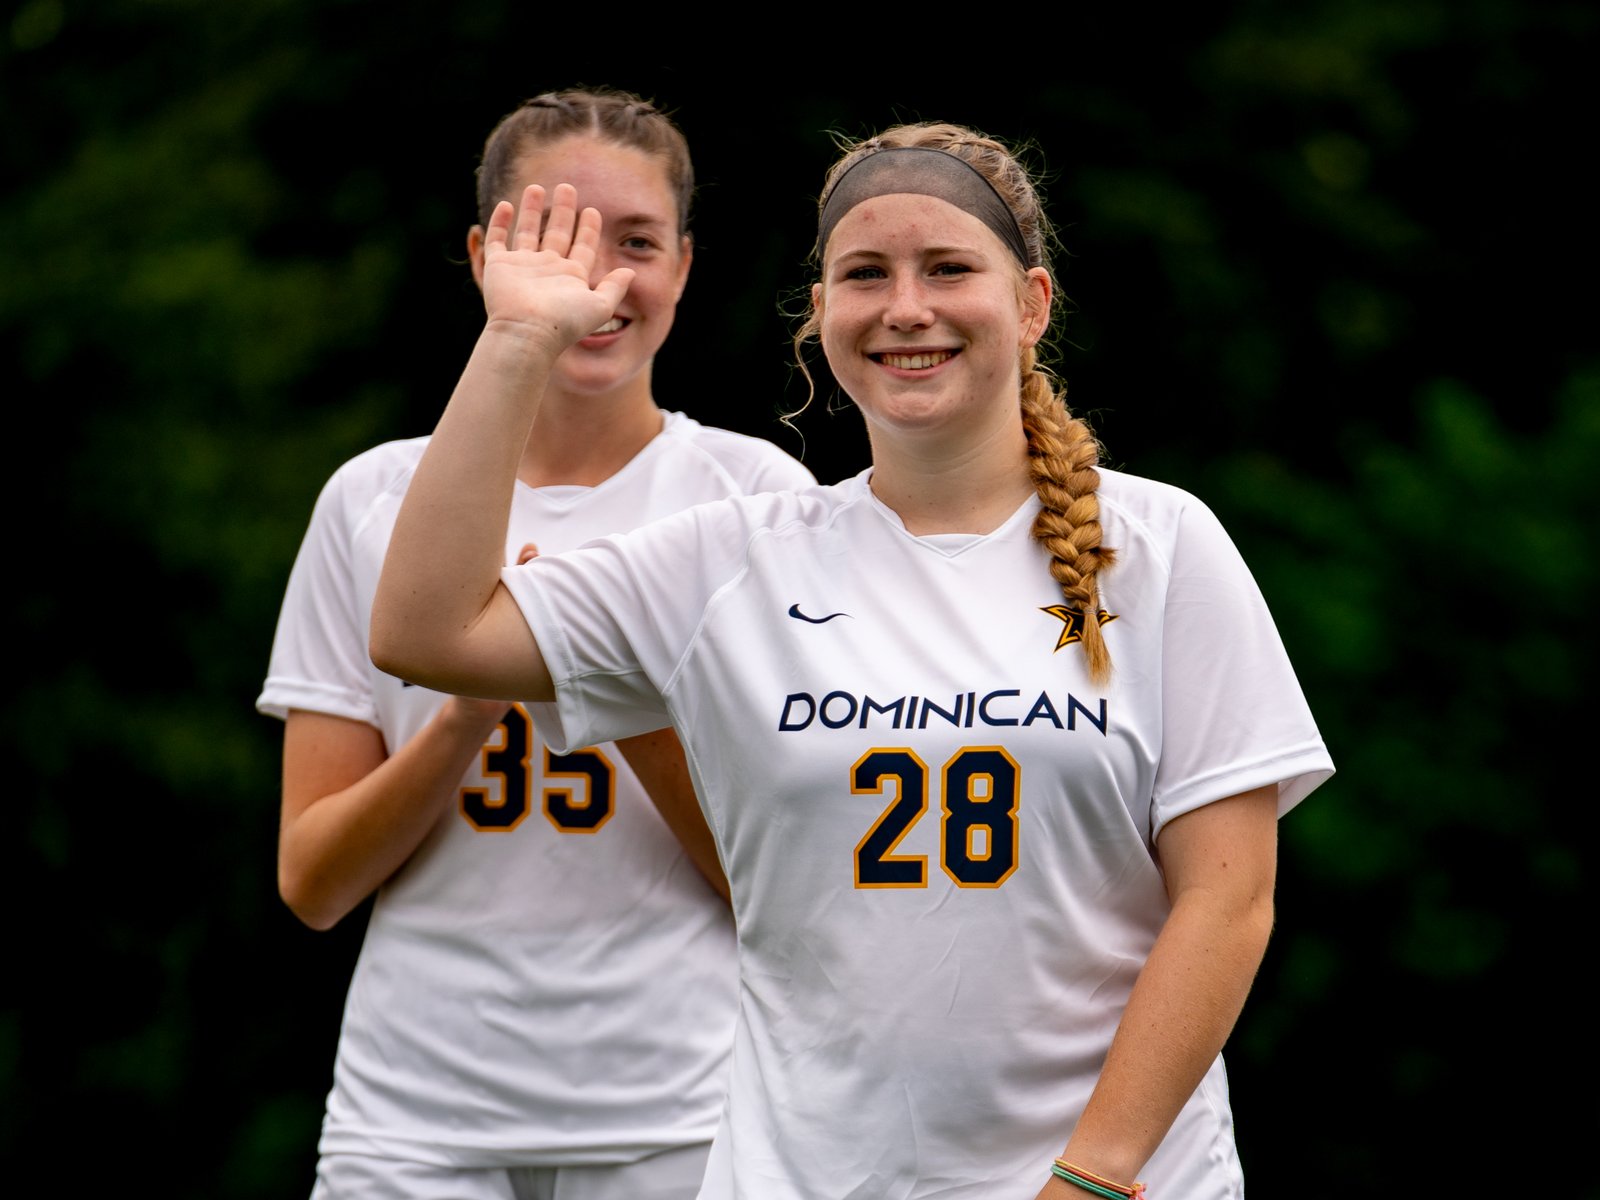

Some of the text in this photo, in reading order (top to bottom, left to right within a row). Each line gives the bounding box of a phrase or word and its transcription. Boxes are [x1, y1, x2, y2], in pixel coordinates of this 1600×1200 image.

[459, 702, 616, 834] 35
[778, 689, 1107, 737] DOMINICAN
[850, 745, 1021, 889] 28
